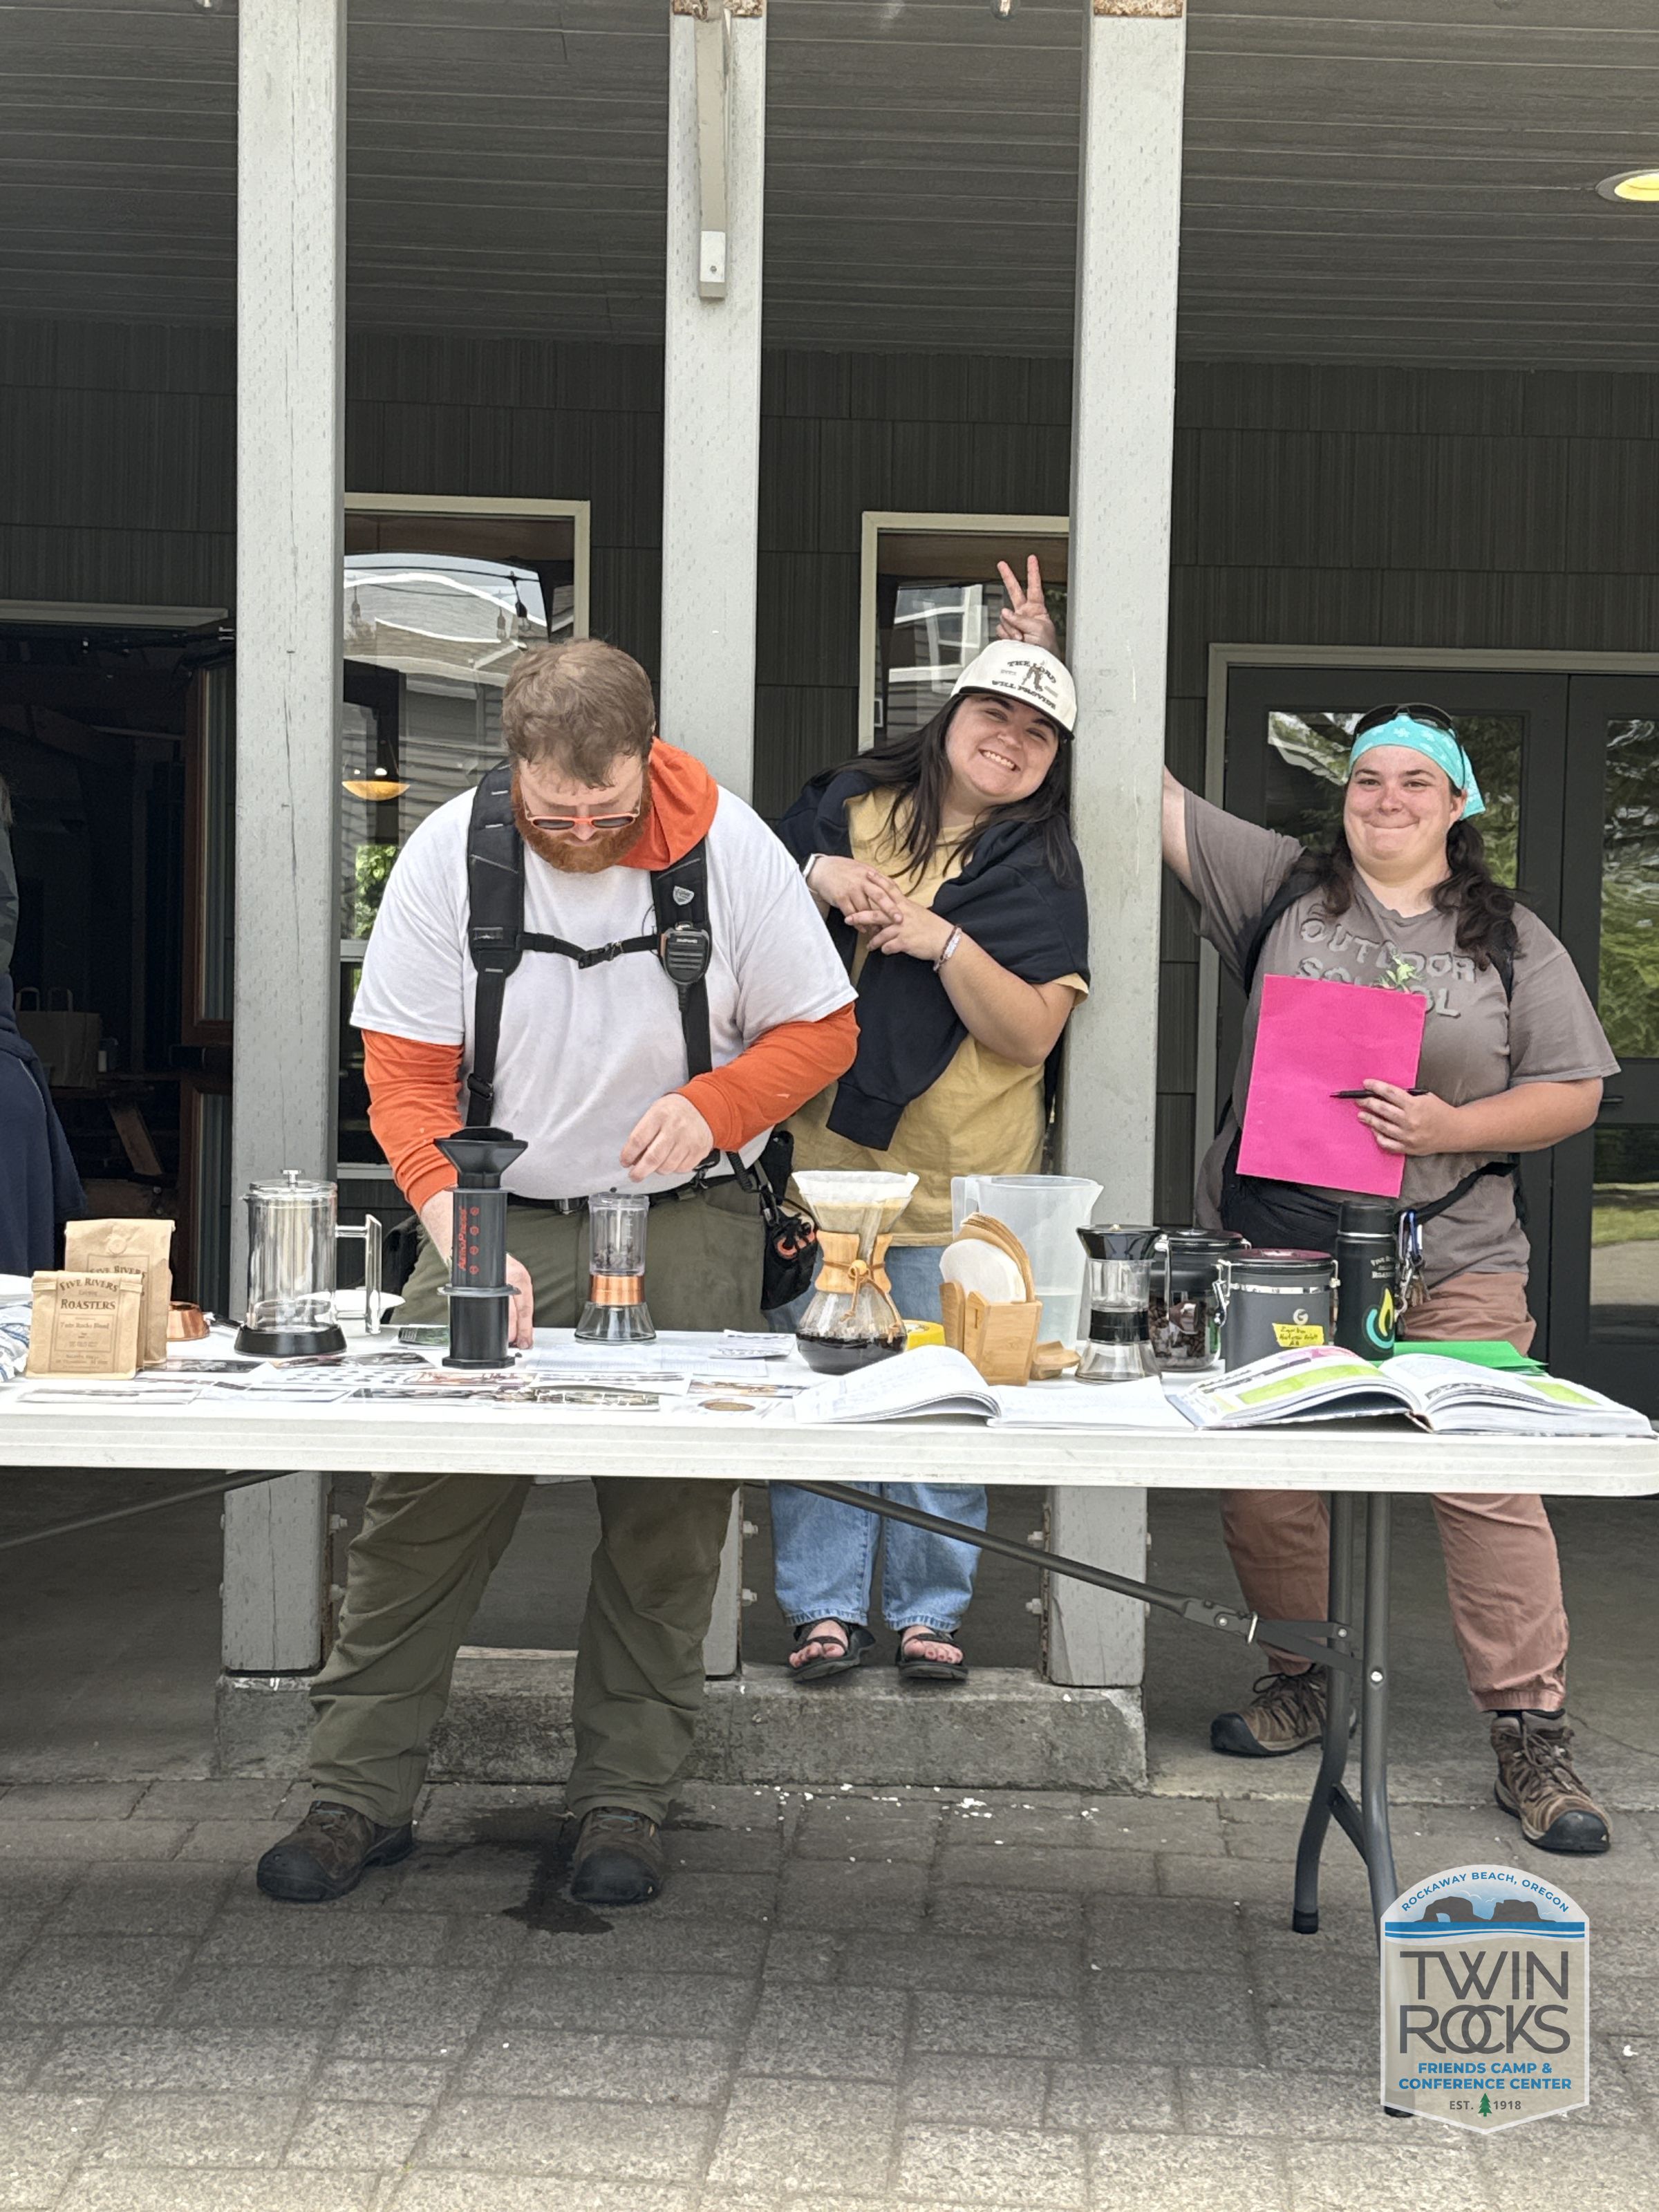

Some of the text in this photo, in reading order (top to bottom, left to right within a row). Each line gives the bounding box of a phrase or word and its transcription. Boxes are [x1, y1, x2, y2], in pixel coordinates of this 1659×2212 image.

[992, 680, 1016, 689] WILL
[1018, 685, 1056, 710] PROVIDE
[59, 1277, 120, 1292] FIVE RIVERS
[61, 1299, 116, 1310] ROASTERS
